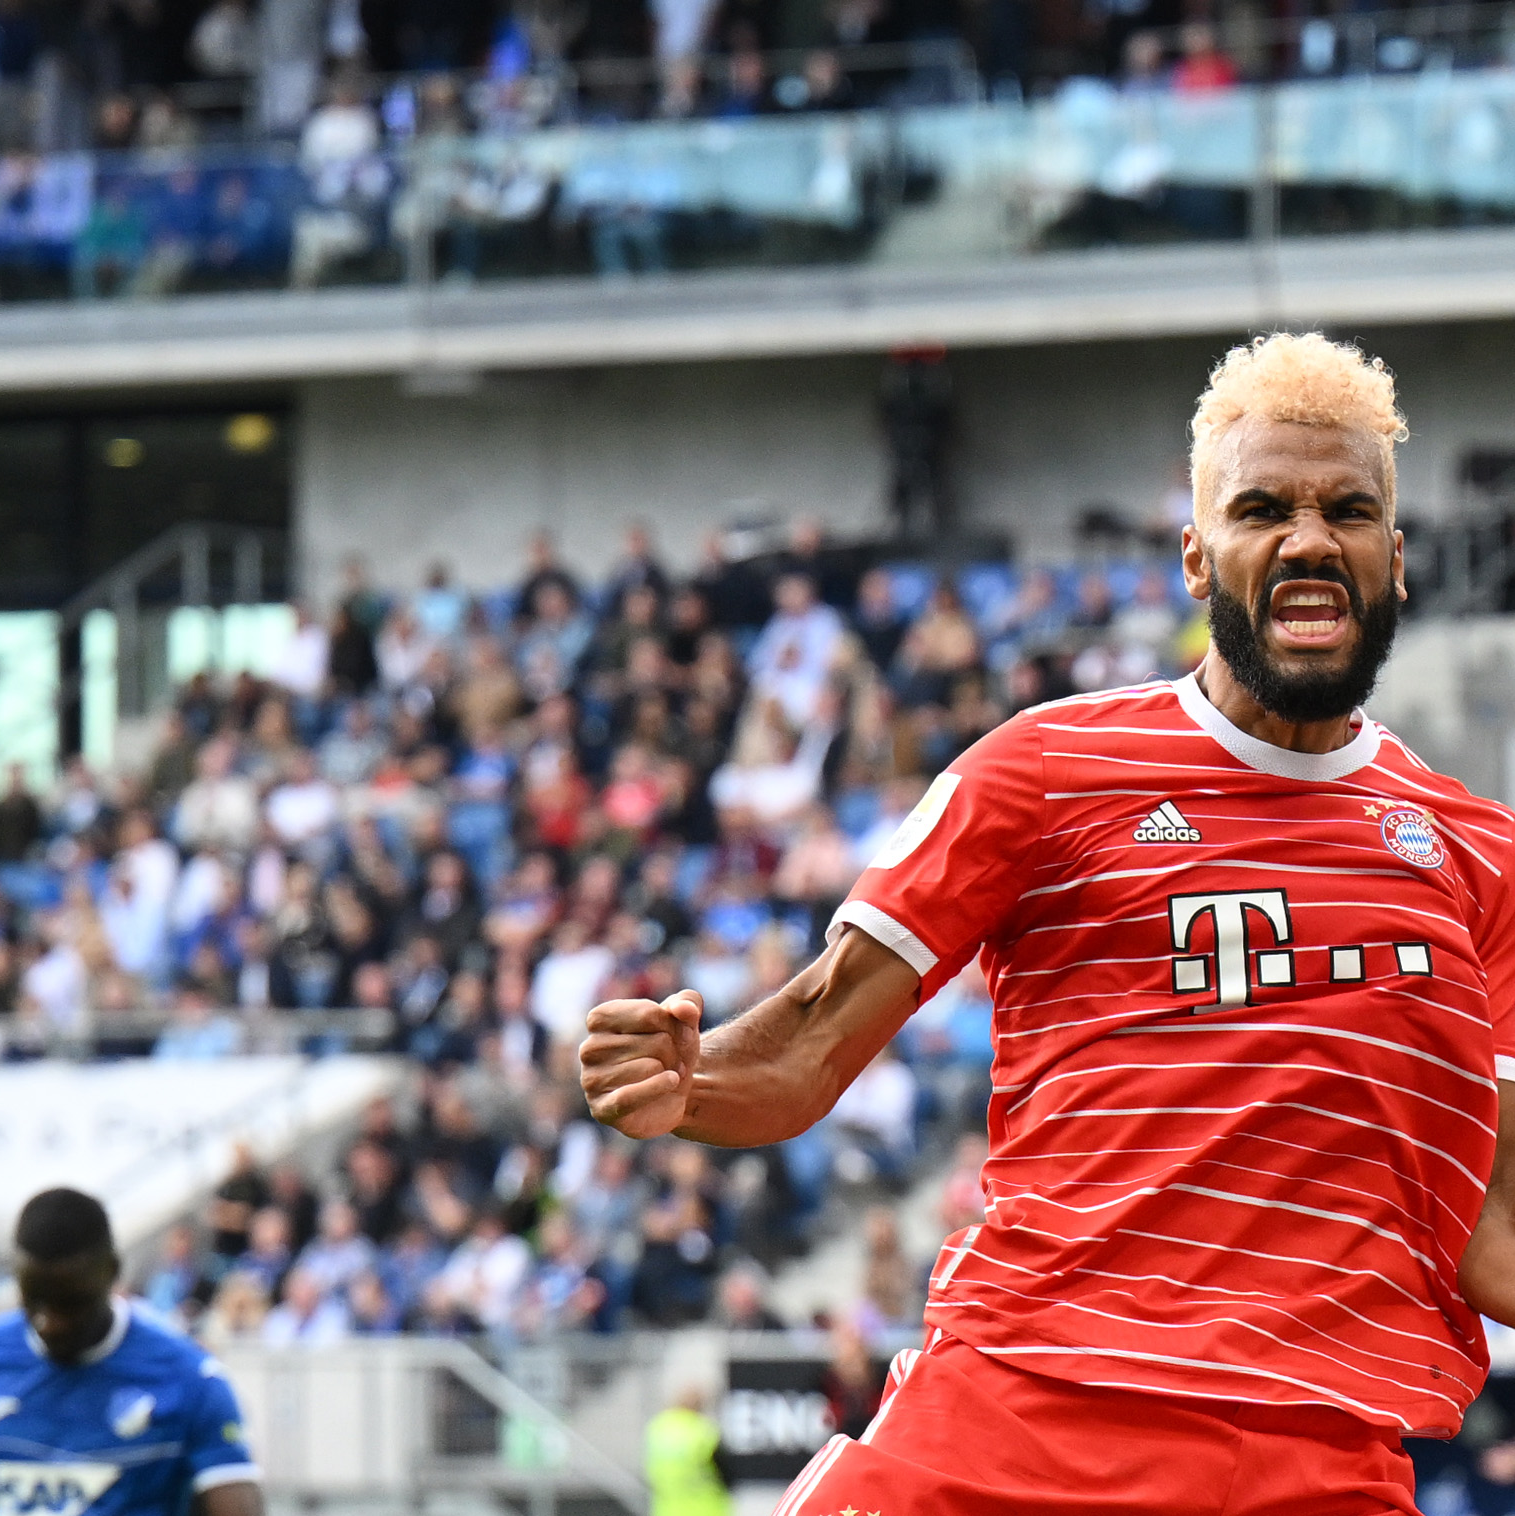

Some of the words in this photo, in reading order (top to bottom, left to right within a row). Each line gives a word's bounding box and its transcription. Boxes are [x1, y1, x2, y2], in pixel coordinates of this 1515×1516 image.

[1132, 825, 1202, 843] adidas
[1386, 816, 1399, 831] FC
[1398, 814, 1439, 844] BAYERN
[1388, 838, 1441, 865] MÜNCHEN
